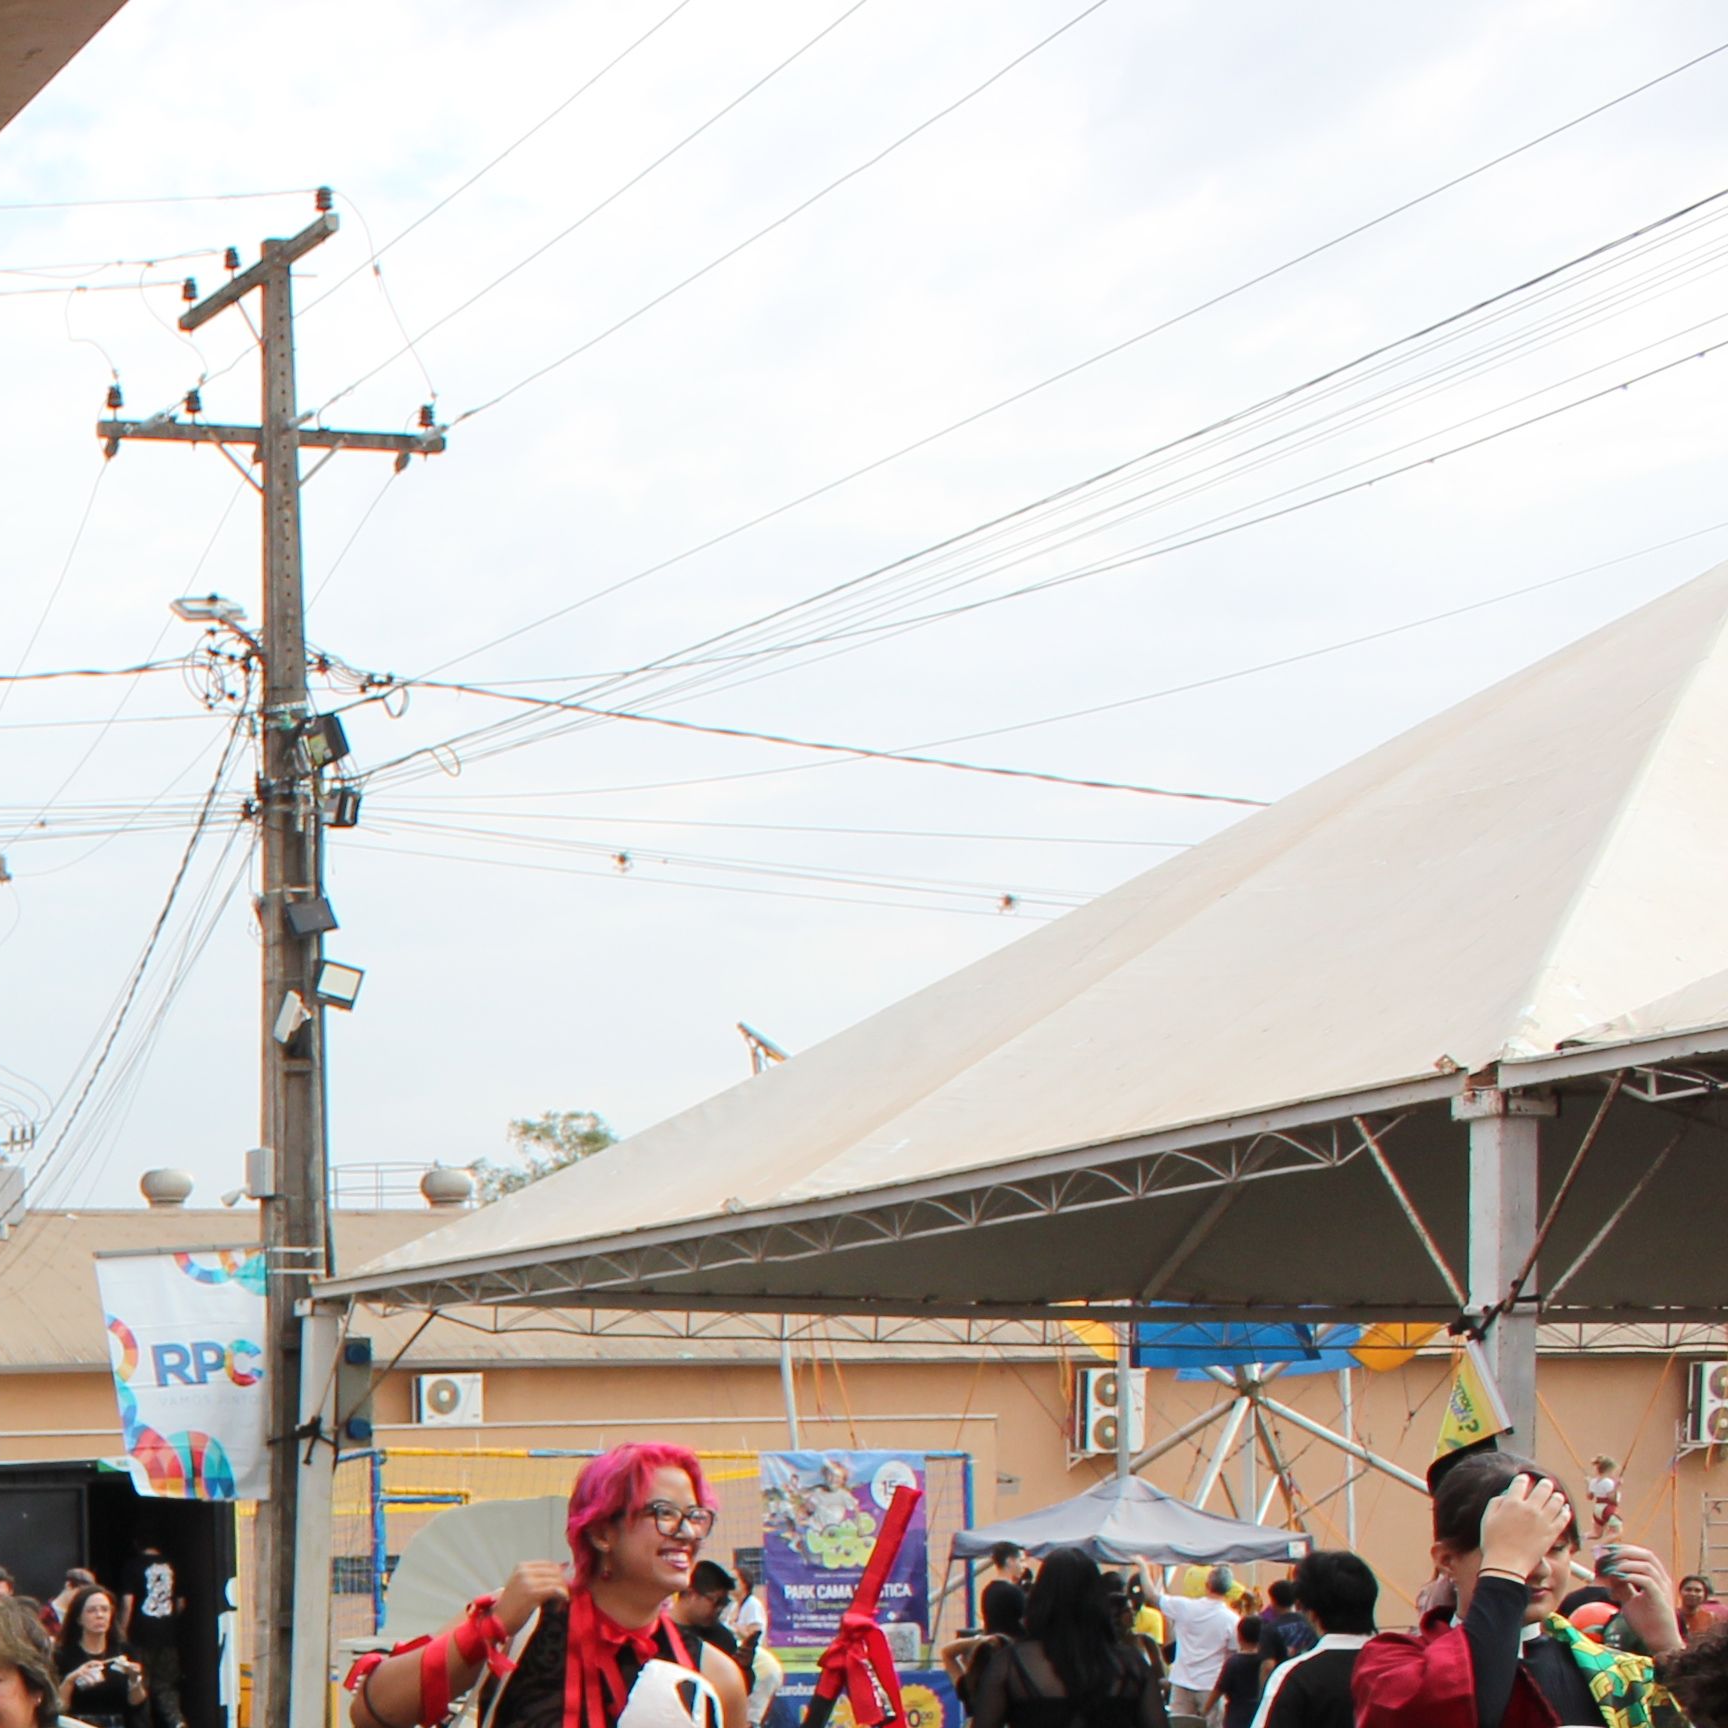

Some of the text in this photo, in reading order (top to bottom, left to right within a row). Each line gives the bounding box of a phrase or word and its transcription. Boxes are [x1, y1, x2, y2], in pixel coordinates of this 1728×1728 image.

[151, 1339, 264, 1387] RPC
[784, 1584, 816, 1600] PARK
[816, 1584, 853, 1600] CAMA
